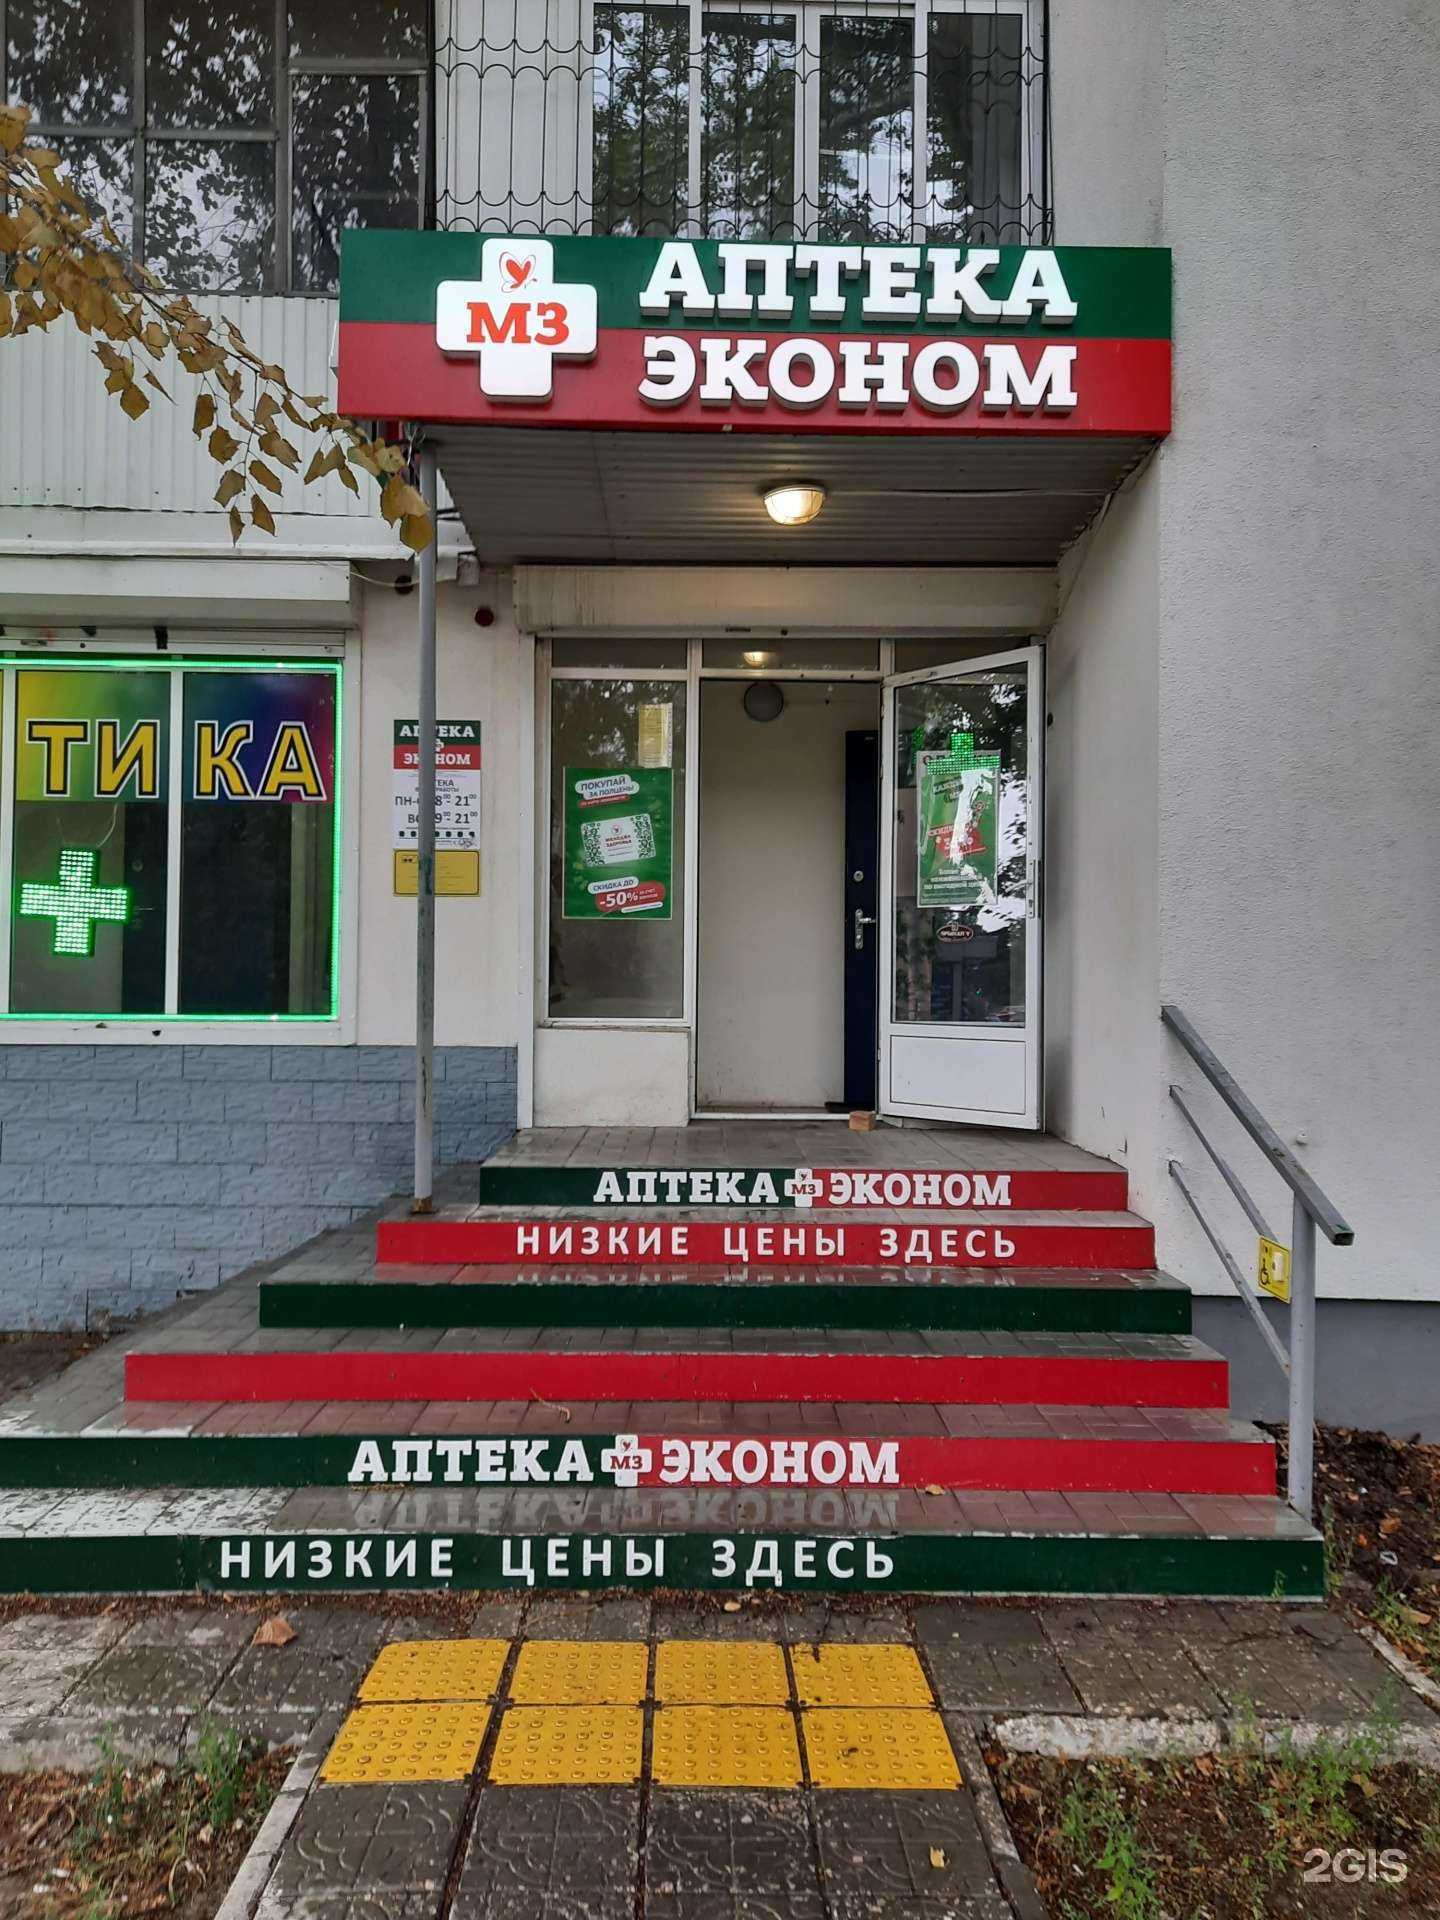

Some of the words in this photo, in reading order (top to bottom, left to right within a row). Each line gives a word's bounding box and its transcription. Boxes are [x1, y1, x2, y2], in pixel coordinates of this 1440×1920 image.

[639, 242, 1078, 325] АПТЕКА
[638, 336, 1078, 408] ЭКОНОМ
[581, 776, 626, 791] ПОКУПАЙ
[593, 883, 621, 892] СКИДКА
[600, 891, 639, 908] -50%
[594, 1171, 780, 1204] АПТЕКА
[828, 1173, 1011, 1206] ЭКОНОМ
[517, 1226, 688, 1255] НИЗКИЕ
[724, 1227, 845, 1262] ЦЕНЫ
[879, 1228, 1015, 1264] ЗДЕСЬ
[347, 1439, 594, 1482] АПТЕКА
[659, 1440, 900, 1484] ЭКОНОМ
[220, 1538, 454, 1579] НИЗКИЕ
[502, 1539, 665, 1586] ЦЕНЫ
[711, 1540, 894, 1587] ЗДЕСЬ
